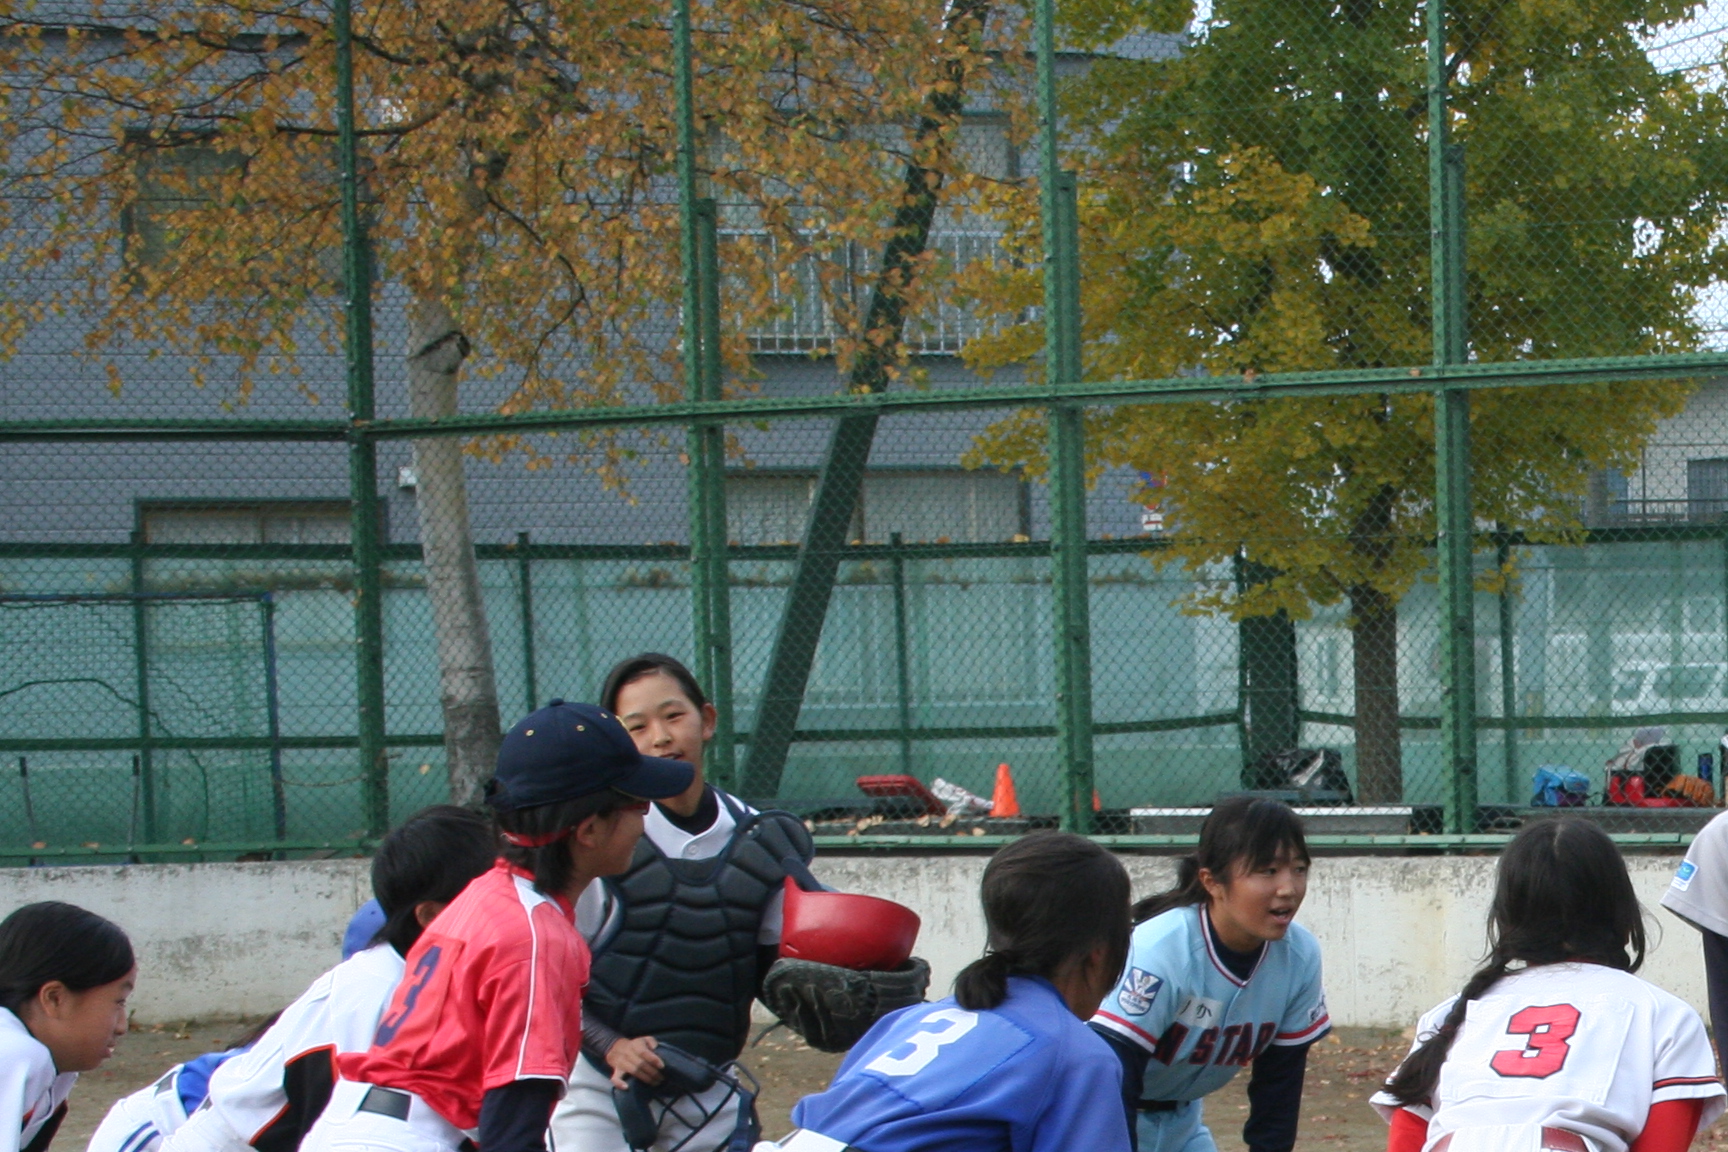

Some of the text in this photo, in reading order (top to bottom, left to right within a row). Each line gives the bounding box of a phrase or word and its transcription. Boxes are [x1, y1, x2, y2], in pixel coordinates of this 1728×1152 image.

[374, 944, 442, 1048] 3
[864, 1008, 979, 1077] 3
[1489, 1002, 1583, 1080] 3
